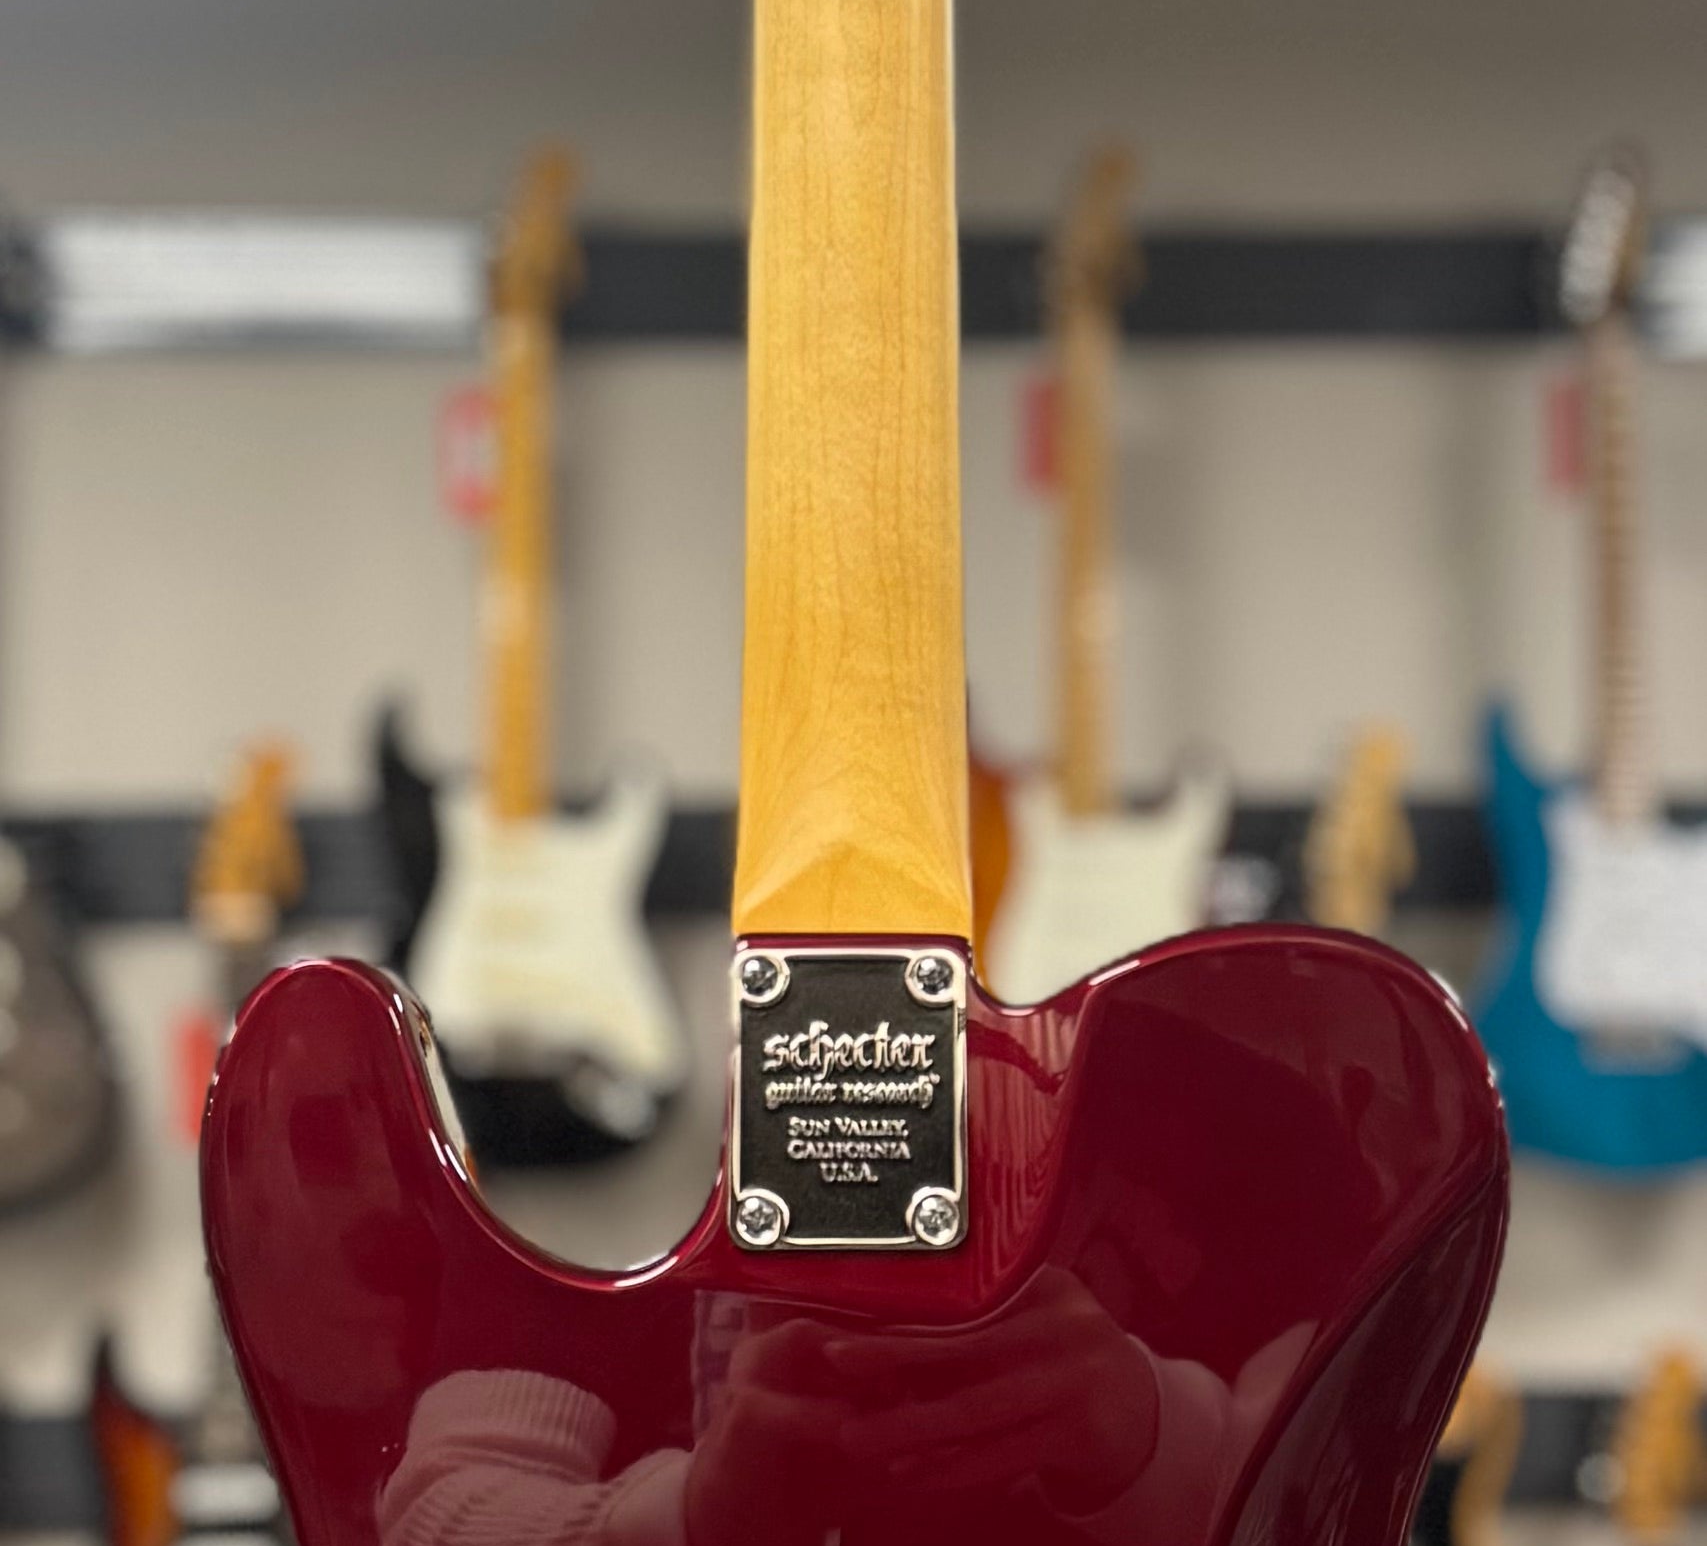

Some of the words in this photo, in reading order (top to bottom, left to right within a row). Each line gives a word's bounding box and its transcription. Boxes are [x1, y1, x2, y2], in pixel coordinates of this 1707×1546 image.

[765, 1076, 838, 1110] guitar
[788, 1116, 831, 1137] SUN
[834, 1117, 909, 1138] VALLEY,
[787, 1139, 912, 1160] CALIFORNIA
[820, 1161, 879, 1183] U.S.A.
